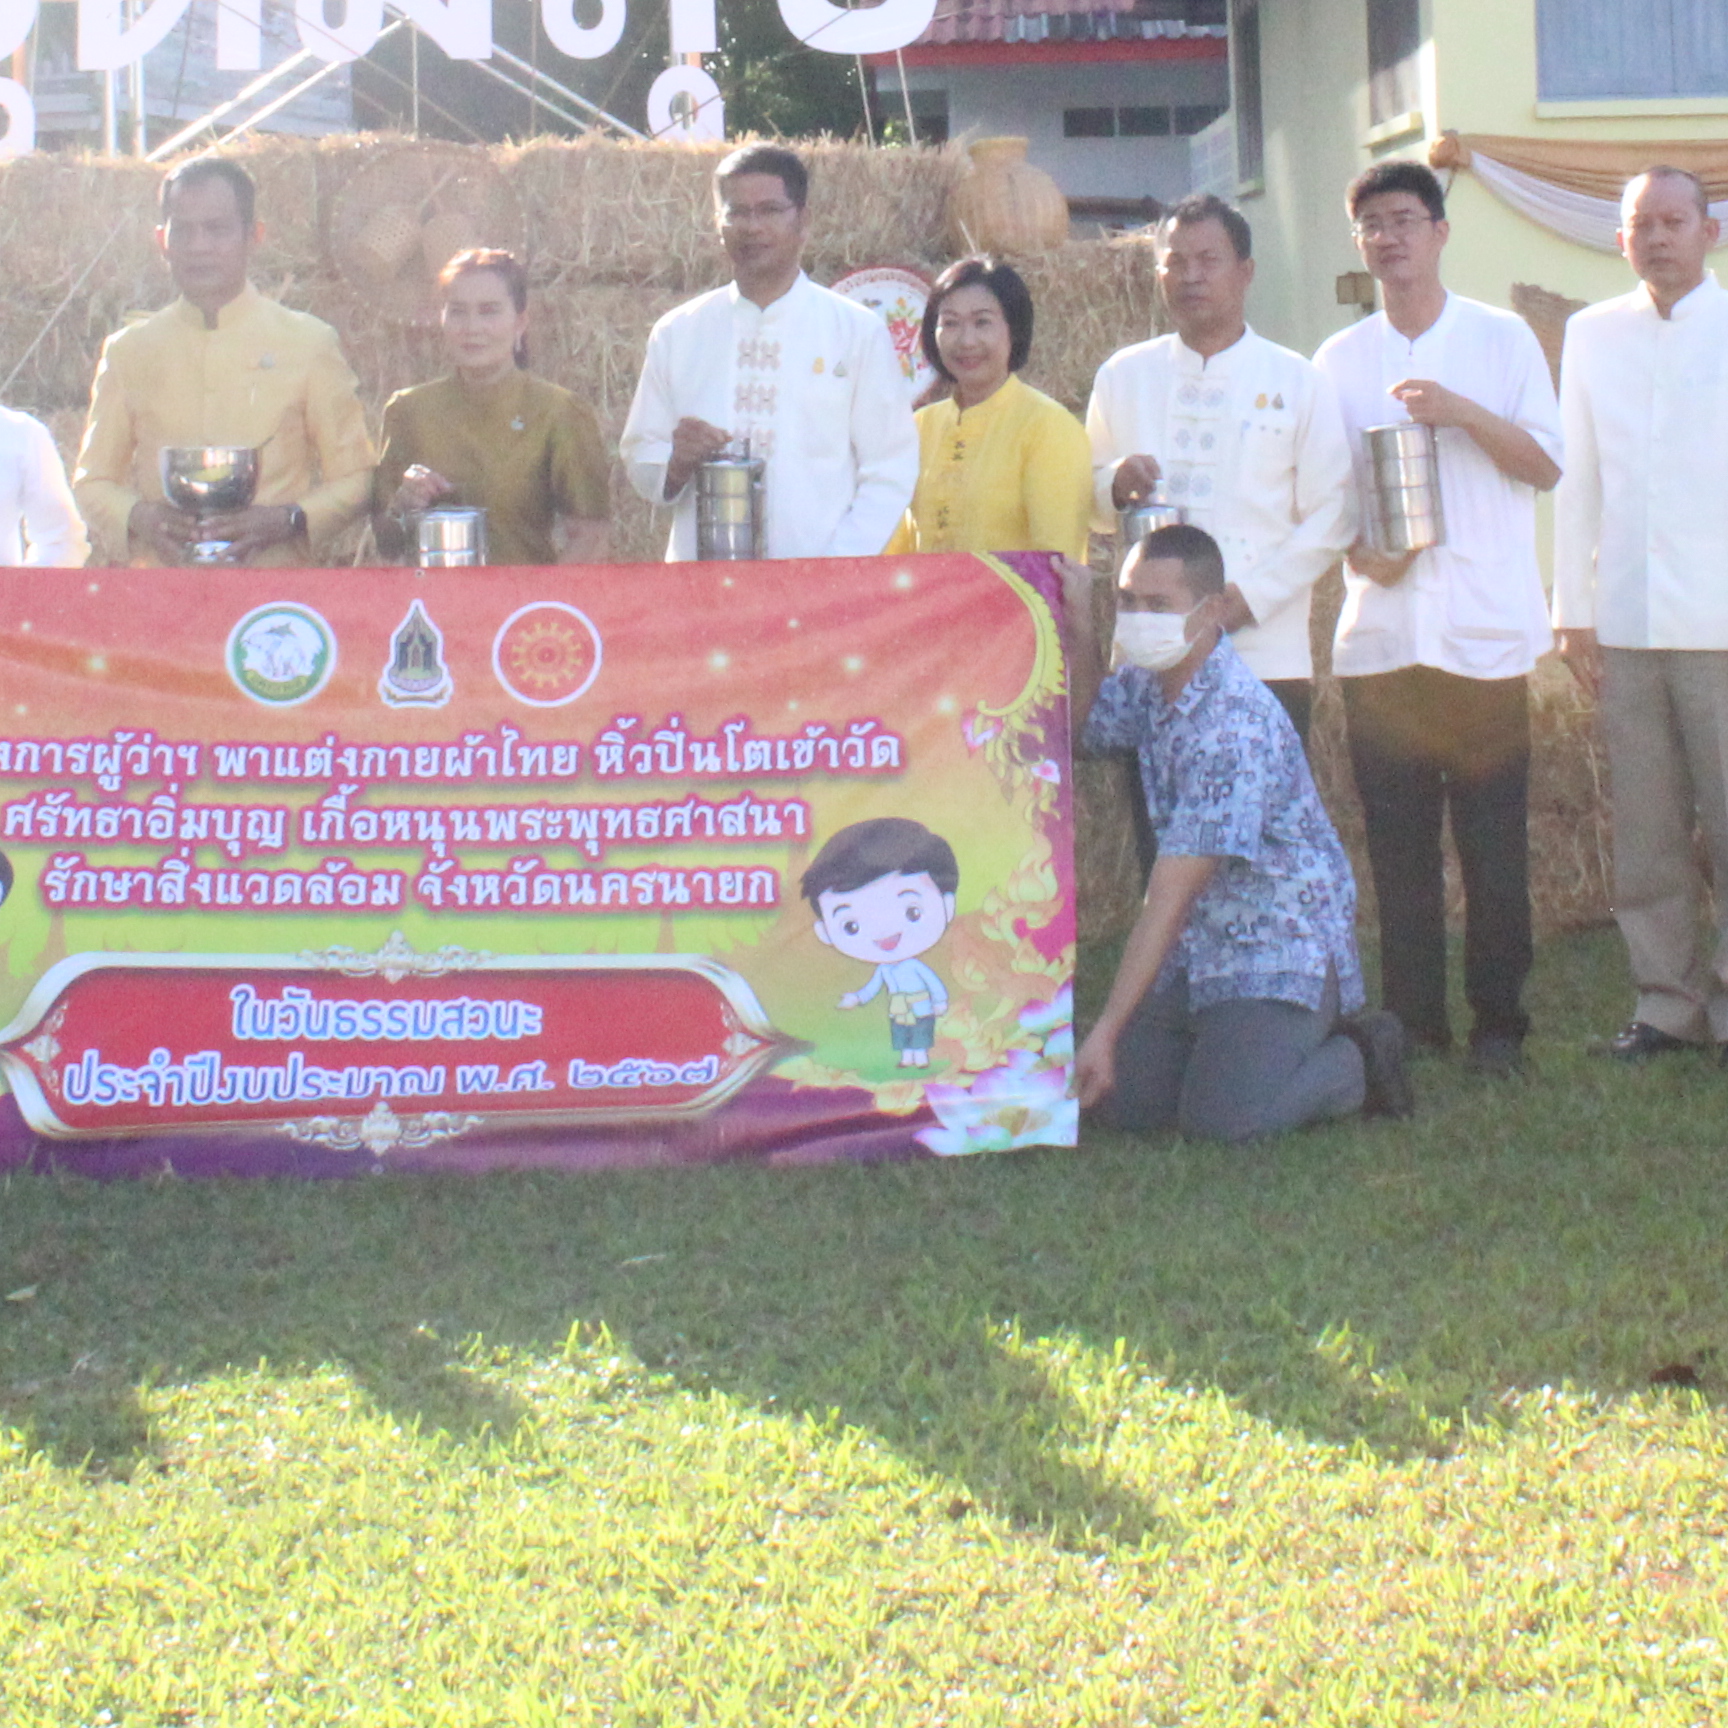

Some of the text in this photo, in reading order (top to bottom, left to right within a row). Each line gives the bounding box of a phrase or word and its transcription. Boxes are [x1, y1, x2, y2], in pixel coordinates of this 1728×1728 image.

[215, 727, 579, 779] พาแต่งกายผ้าไทย
[595, 718, 902, 776] หิ้วปิ่นโตเข้าวัด
[2, 784, 807, 857] ศรัทธาอิ่มบุญ เกื้อหนุนพระพุทธศาสนา
[43, 848, 774, 909] รักษาสิ่งแวดล้อม จังหวัดนครนายก
[229, 983, 542, 1041] ในวันธรรมสวนะ
[62, 1046, 720, 1107] ประจำปีงบประมาณ พ.ศ. ๒๕๖๗
